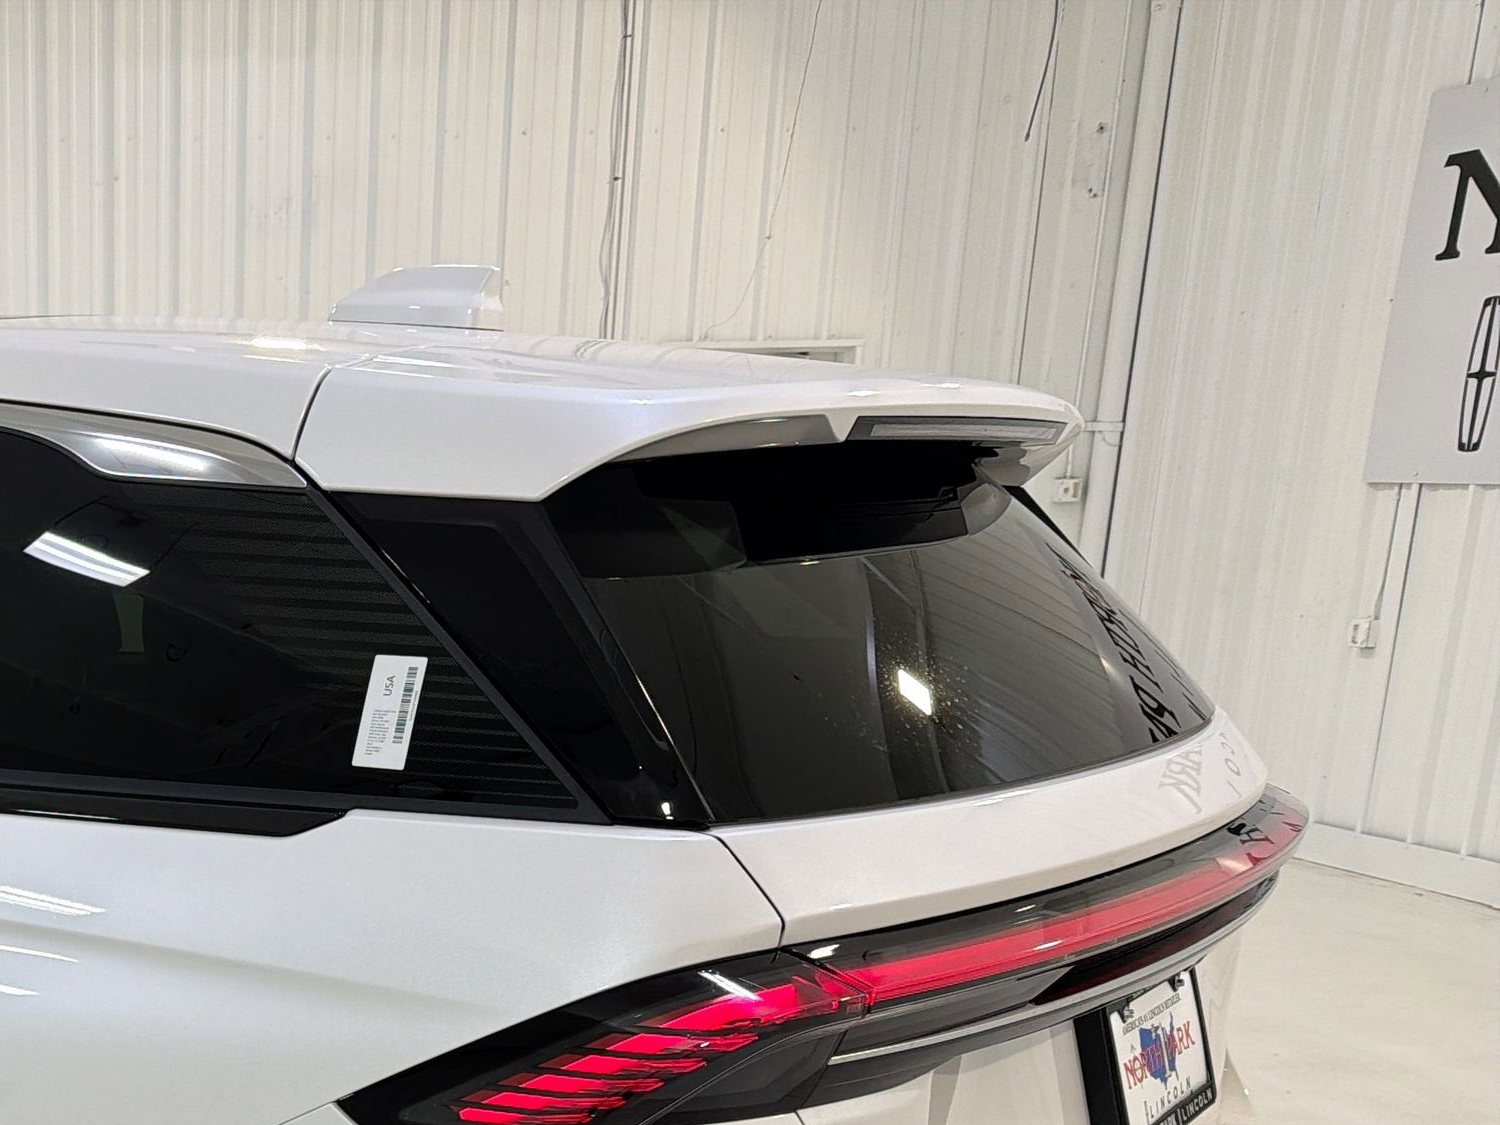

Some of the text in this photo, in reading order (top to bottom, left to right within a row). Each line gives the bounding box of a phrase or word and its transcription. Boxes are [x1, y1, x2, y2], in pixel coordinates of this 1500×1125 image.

[382, 674, 396, 697] USA
[1123, 1021, 1195, 1090] NORTH PARK
[1149, 1076, 1194, 1119] LINCOLN
[1181, 1087, 1214, 1122] LINCOLN
